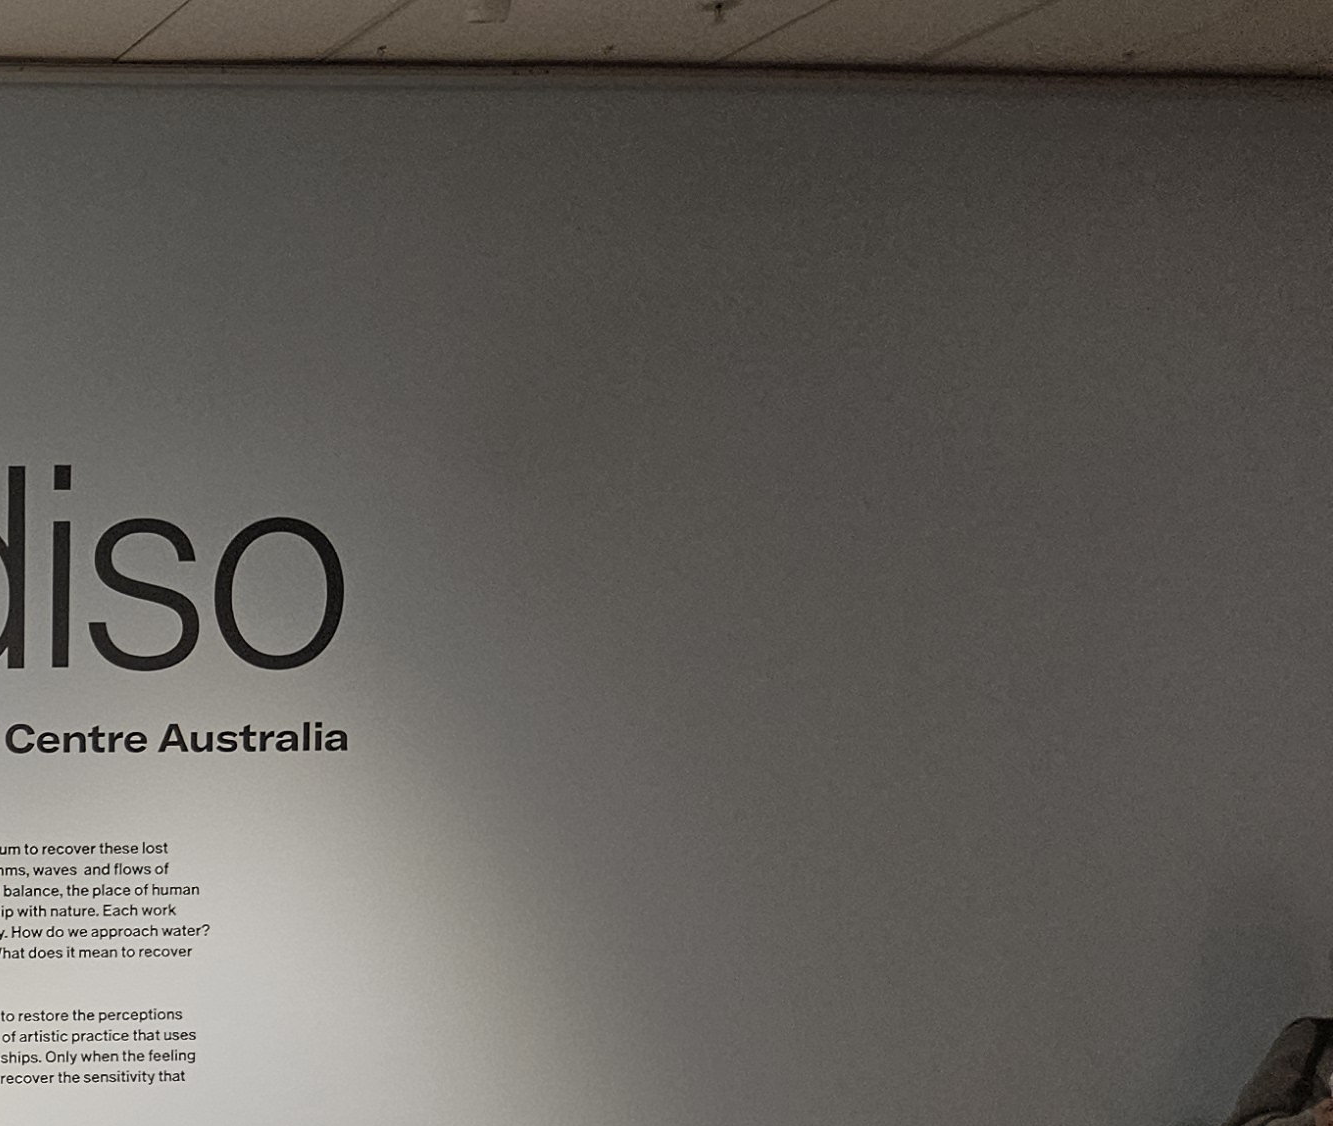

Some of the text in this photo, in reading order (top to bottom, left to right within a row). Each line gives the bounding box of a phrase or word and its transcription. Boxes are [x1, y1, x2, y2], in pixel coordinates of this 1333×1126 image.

[5, 724, 147, 754] Centre
[158, 722, 347, 753] Australia
[3, 885, 63, 899] balance,
[65, 884, 90, 896] the
[92, 884, 131, 899] place
[134, 884, 150, 896] of
[152, 884, 199, 896] human
[0, 1011, 16, 1022] to
[18, 1010, 69, 1022] restore
[71, 1009, 96, 1021] the
[98, 1008, 182, 1023] perceptions
